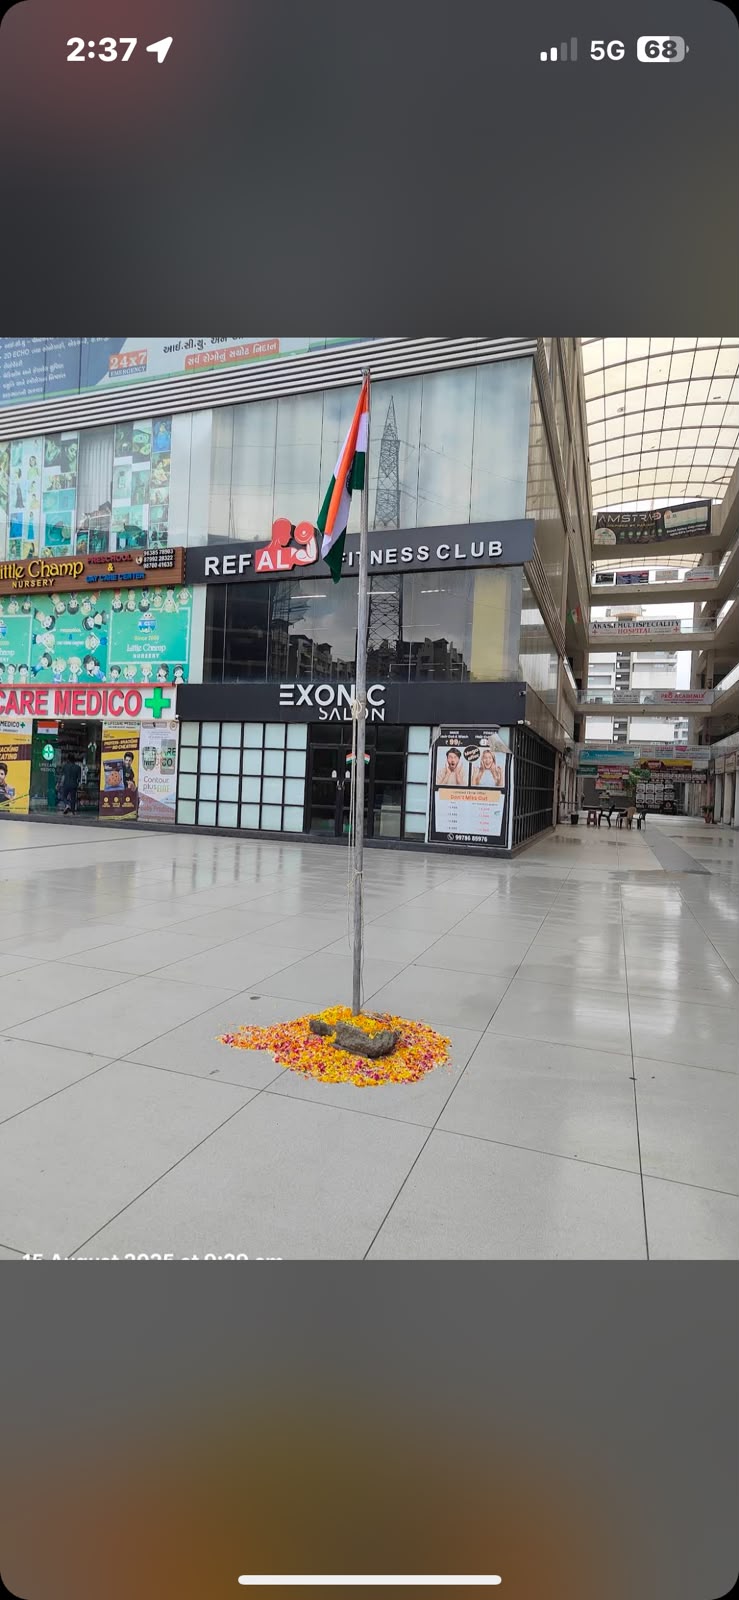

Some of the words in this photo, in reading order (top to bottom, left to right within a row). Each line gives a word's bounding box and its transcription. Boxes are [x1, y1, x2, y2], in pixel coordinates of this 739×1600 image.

[12, 348, 30, 358] ECHO
[111, 352, 147, 370] 24x7
[110, 366, 147, 377] EMERGENCY
[598, 511, 662, 523] AMSTRAD
[436, 540, 503, 560] CLUB
[87, 555, 133, 564] PRESCHOOL
[0, 563, 25, 580] ittle
[27, 560, 85, 579] Champ
[107, 563, 114, 572] &
[119, 572, 146, 581] CENTER
[11, 579, 55, 589] NURSERY
[126, 643, 142, 652] Little
[142, 643, 167, 653] Champ
[279, 684, 386, 707] EXONC
[54, 689, 143, 717] MEDICO
[143, 776, 170, 784] Contour
[143, 783, 157, 793] plus
